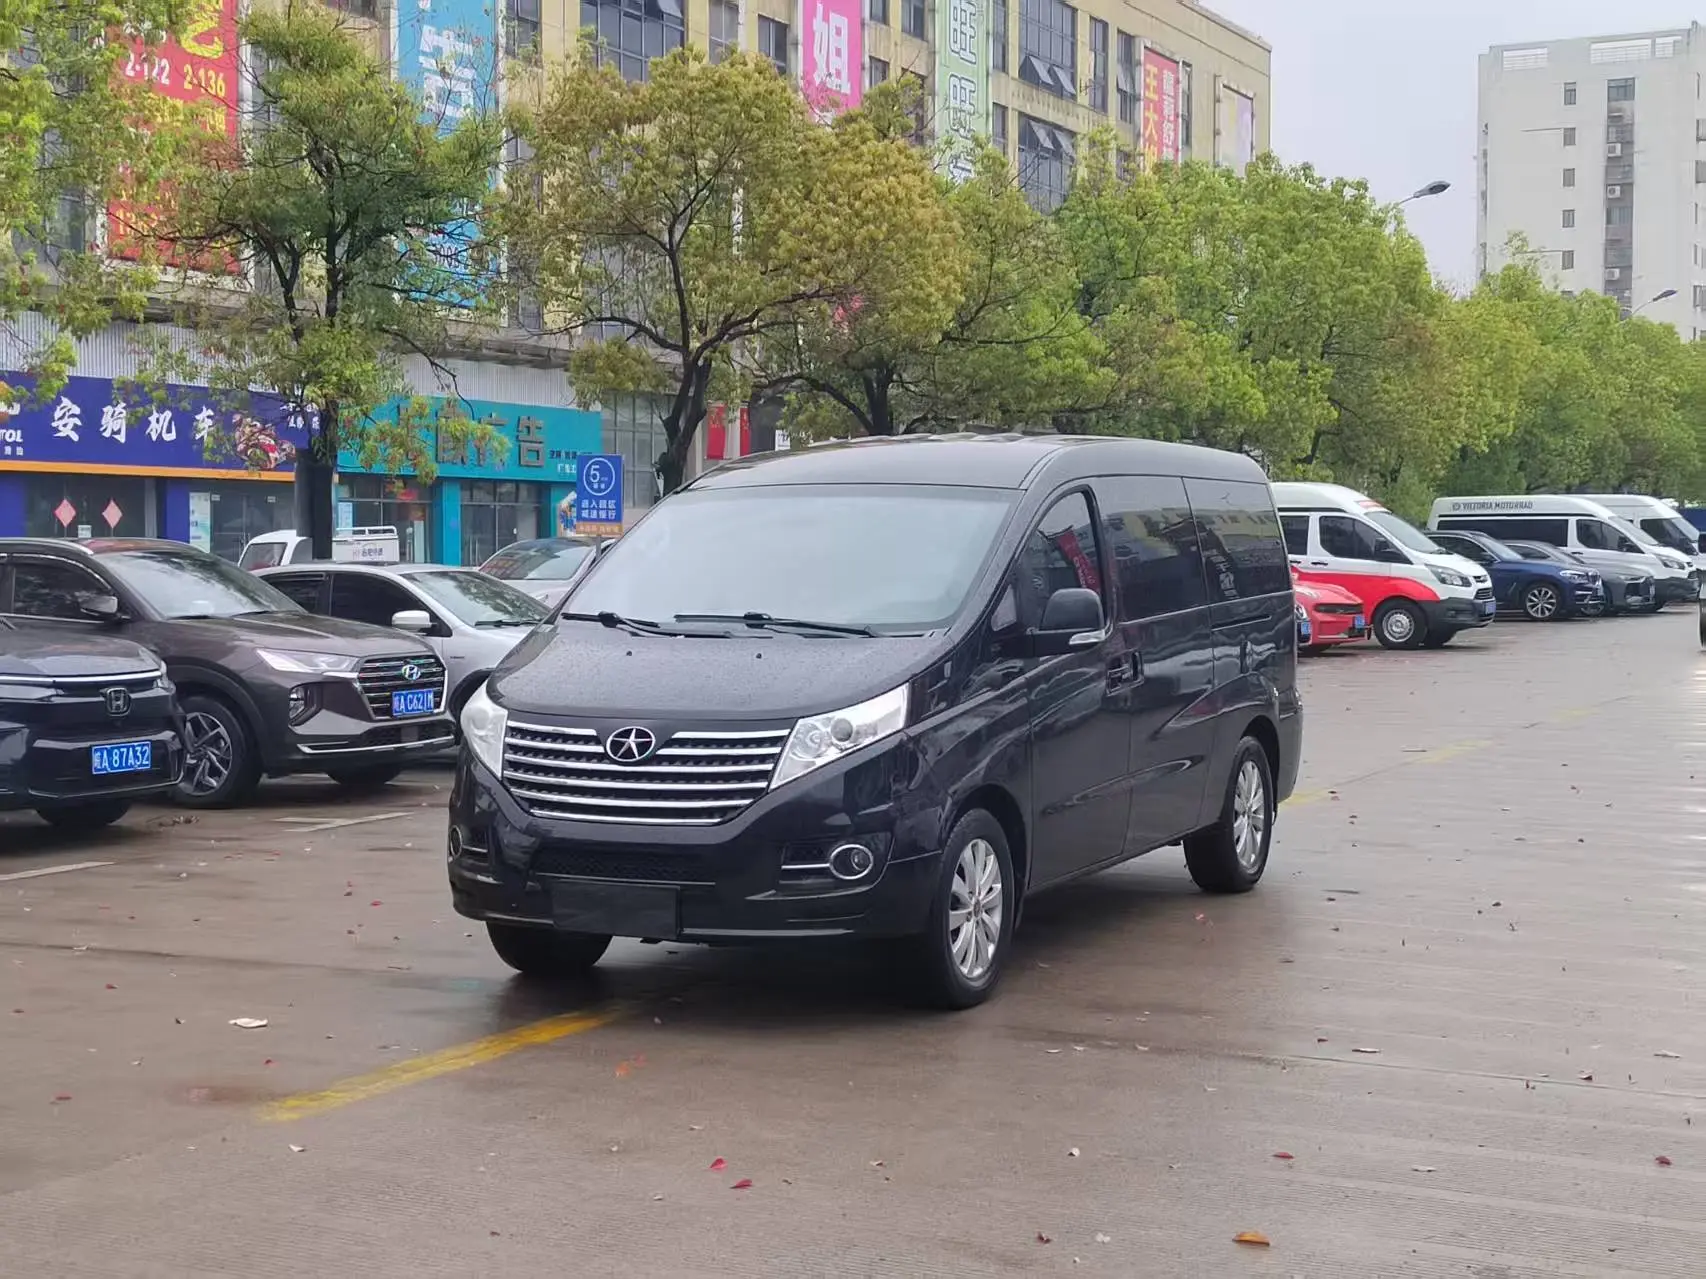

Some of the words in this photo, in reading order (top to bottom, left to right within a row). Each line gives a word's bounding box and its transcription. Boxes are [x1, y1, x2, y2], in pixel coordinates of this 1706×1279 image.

[51, 396, 216, 443] 安骑机车
[590, 465, 600, 483] 5
